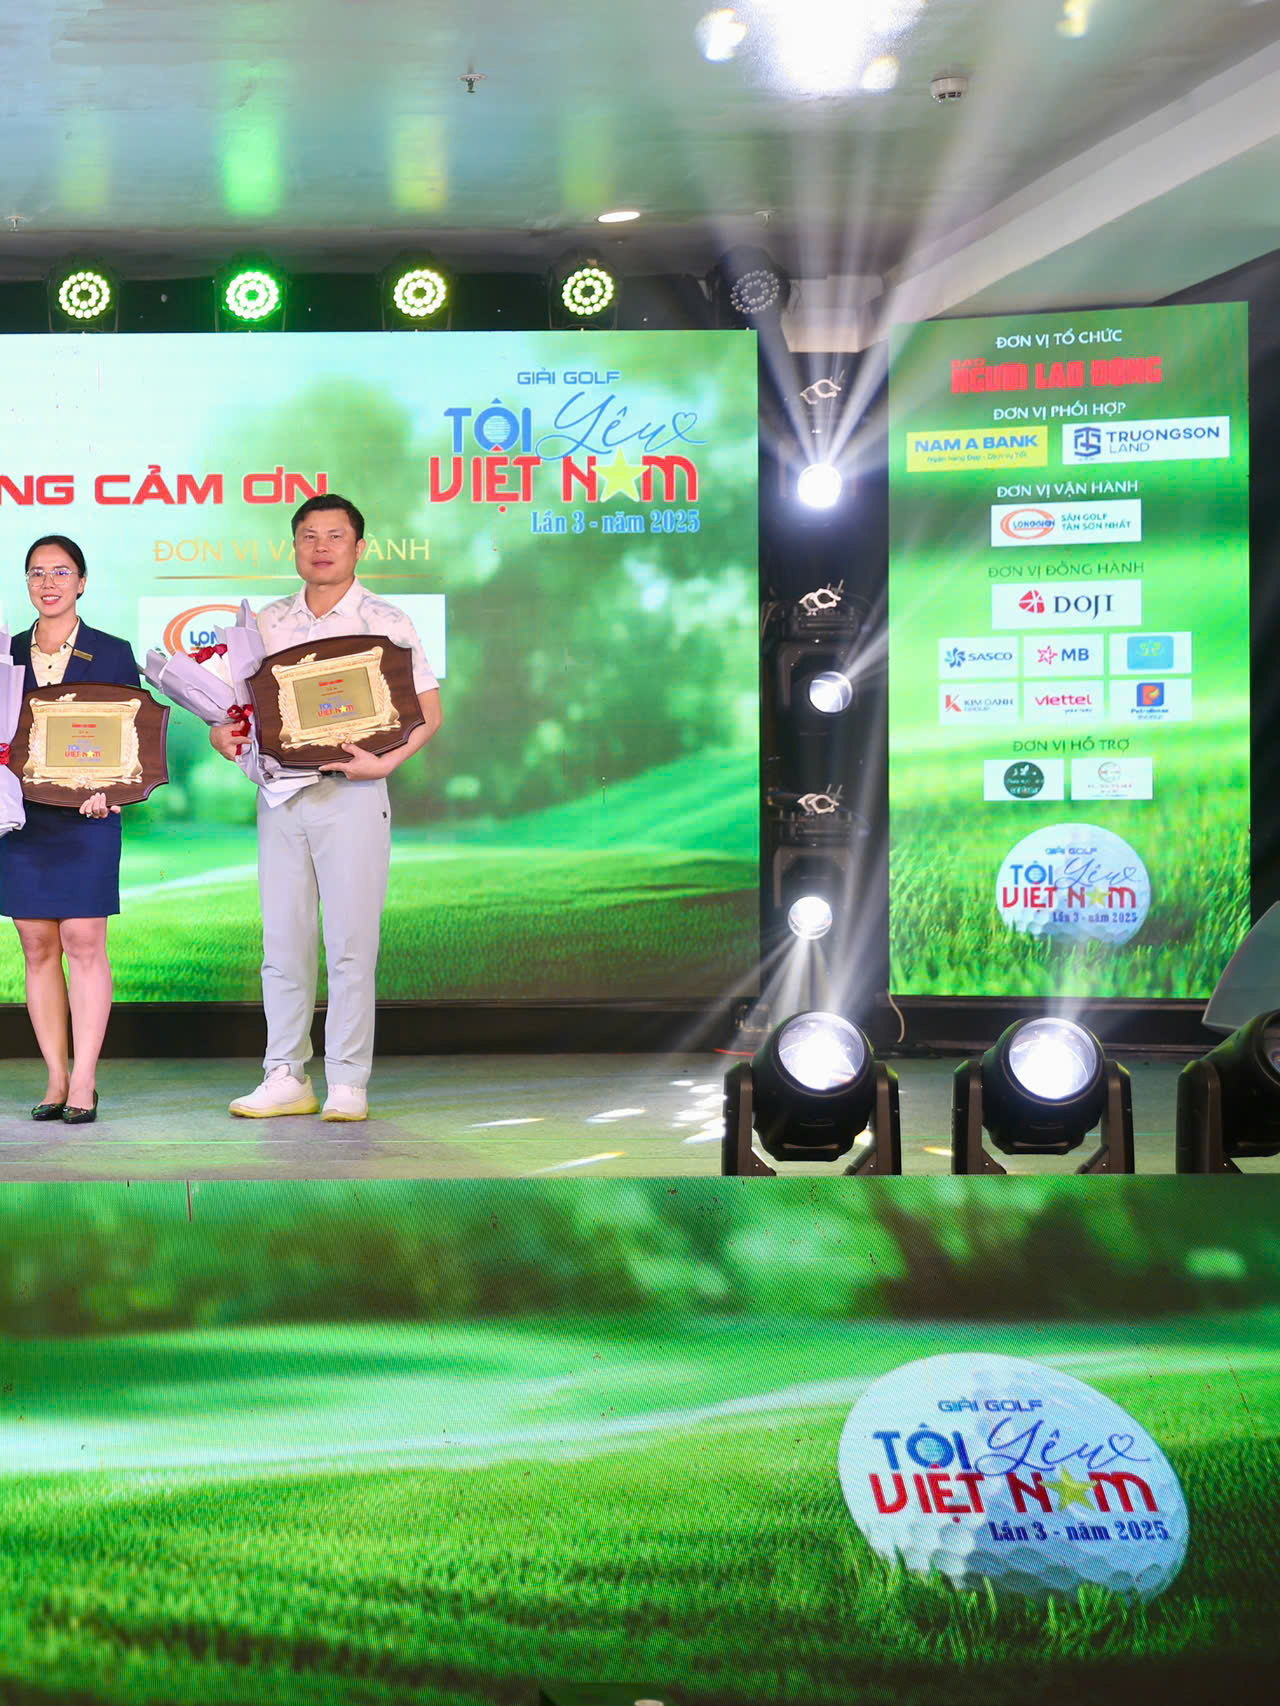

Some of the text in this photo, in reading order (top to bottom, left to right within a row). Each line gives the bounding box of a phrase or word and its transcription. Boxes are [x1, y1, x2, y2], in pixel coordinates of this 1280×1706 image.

[996, 336, 1031, 349] ĐƠN
[1035, 334, 1049, 348] VỊ
[1078, 329, 1123, 345] CHỨC
[517, 368, 620, 385] GIẢI GOLF
[1035, 361, 1084, 389] LAO
[993, 400, 1127, 420] ĐƠN VỊ PHỐI HỢP
[443, 392, 705, 461] TÔI Yêu
[1106, 426, 1220, 442] TRUONGSON
[914, 434, 1038, 453] NAM A BANK
[1109, 442, 1150, 454] LAND
[94, 465, 224, 505] CẢM
[243, 466, 328, 505] ƠN
[429, 445, 541, 513] VIỆT
[997, 479, 1138, 498] ĐƠN VỊ VẬN HÀNH
[532, 510, 567, 533] Lần
[573, 511, 585, 533] 3
[602, 511, 645, 533] năm
[650, 510, 700, 533] 2025
[1083, 512, 1108, 521] GOLF
[152, 538, 223, 562] ĐƠN
[232, 540, 258, 568] VỊ
[364, 533, 430, 561] ÀNH
[988, 565, 1023, 578] ĐƠN
[1028, 564, 1041, 579] VỊ
[1098, 559, 1144, 574] HÀNH
[1053, 593, 1114, 620] DOJI
[968, 651, 1012, 662] SASCO
[1061, 648, 1089, 661] MB
[1035, 694, 1092, 706] viettel
[1013, 739, 1048, 752] ĐƠN
[1052, 739, 1066, 754] VỊ
[1100, 738, 1130, 752] TRỢ
[1010, 857, 1140, 889] TÔI Yêu
[1003, 882, 1058, 912] VIỆT
[1073, 912, 1079, 923] 3
[1112, 911, 1137, 923] 2025
[984, 1399, 1043, 1412] GOLF
[873, 1417, 1148, 1477] TÔI Yêu
[869, 1464, 985, 1523] VIỆT
[1033, 1520, 1048, 1541] 3
[1065, 1520, 1111, 1540] năm
[1114, 1519, 1170, 1540] 2025
